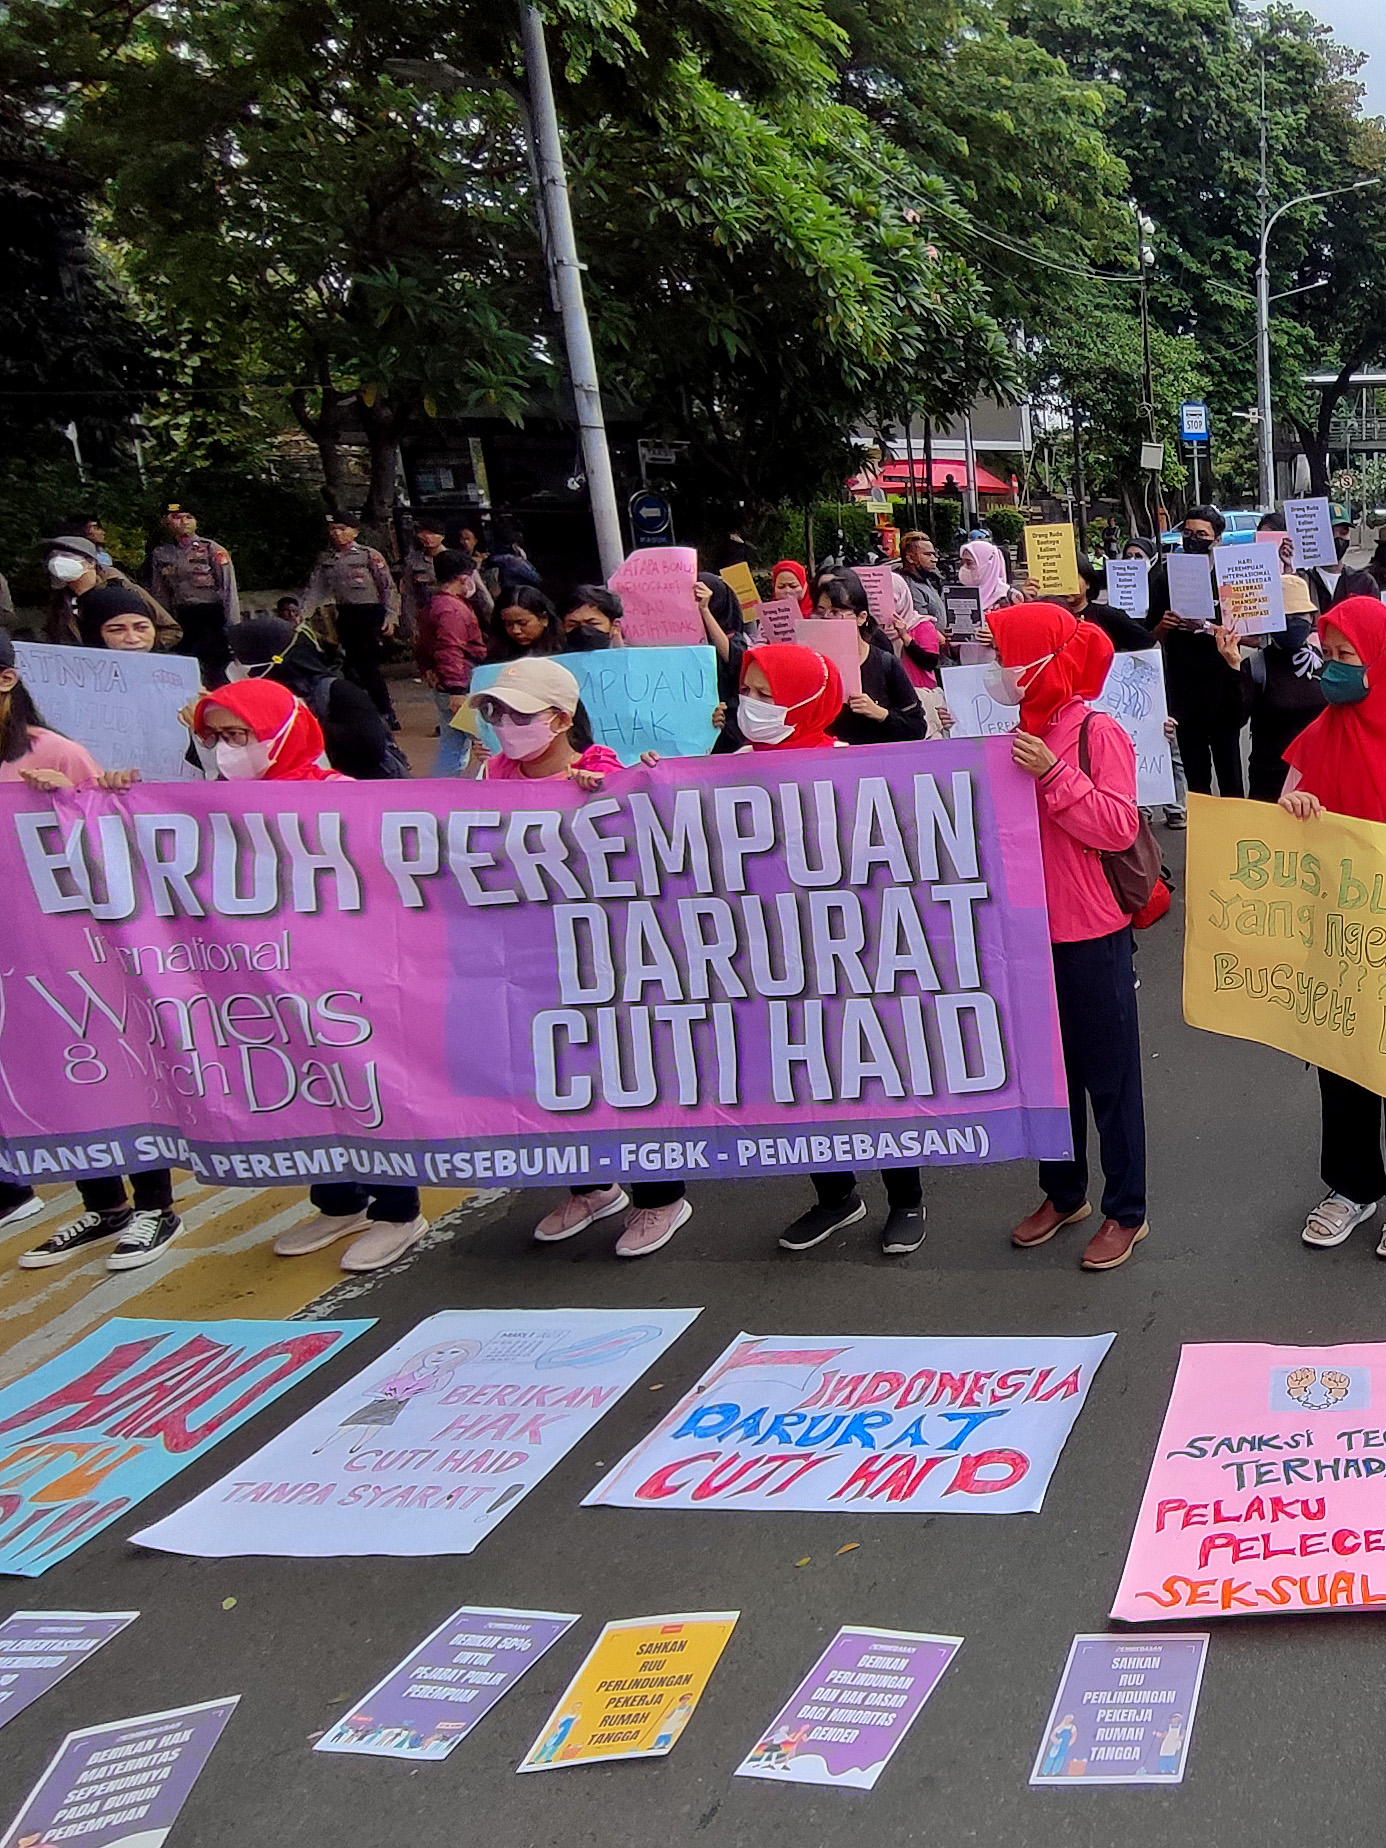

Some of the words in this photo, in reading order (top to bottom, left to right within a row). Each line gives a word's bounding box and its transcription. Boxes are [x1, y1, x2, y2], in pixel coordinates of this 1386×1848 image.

[1187, 421, 1202, 429] STOP
[600, 709, 675, 746] HAK
[381, 771, 980, 908] PEREMPUAN
[553, 882, 989, 1006] DARURAT
[62, 1043, 108, 1084] 8
[531, 1002, 739, 1111] CUTI
[768, 991, 1006, 1103] HAID
[239, 1043, 384, 1129] Day
[212, 1146, 419, 1179] PEREMPUAN
[423, 1144, 590, 1183] (FSEBUMI
[619, 1140, 710, 1172] FGBK
[738, 1125, 990, 1167] PEMBEBASAN)
[436, 1384, 620, 1409] BERIKAN
[794, 1364, 1084, 1412] INDONESIA
[429, 1413, 570, 1446] HAK
[671, 1401, 1010, 1450] DARURAT
[343, 1449, 433, 1472] CUTI
[432, 1449, 529, 1474] HAID
[634, 1451, 841, 1502] CUTI
[827, 1447, 1031, 1503] HAID
[222, 1481, 338, 1506] TANPA
[1155, 1495, 1326, 1533] PELAKU
[635, 1639, 689, 1656] SAHKAN
[639, 1658, 667, 1673] RUU
[1111, 1656, 1161, 1670] SAHKAN
[596, 1674, 694, 1692] PERLINDUNGAN
[824, 1670, 913, 1691] PERLINDUNGAN
[1118, 1674, 1144, 1686] RUU
[604, 1692, 665, 1710] PEKERJA
[810, 1687, 839, 1703] DAN
[1082, 1690, 1176, 1705] PERLINDUNGAN
[598, 1711, 650, 1728] RUMAH
[1096, 1708, 1153, 1722] PEKERJA
[587, 1729, 639, 1746] TANGGA
[1095, 1727, 1144, 1741] RUMAH
[85, 1737, 155, 1766] BERIKAN
[157, 1728, 195, 1750] HAK
[1090, 1746, 1141, 1762] TANGGA
[75, 1748, 182, 1785] MATERNITAS
[52, 1797, 102, 1824] PADA
[101, 1785, 161, 1812] BURUH
[41, 1804, 150, 1844] PEREMPUAN
